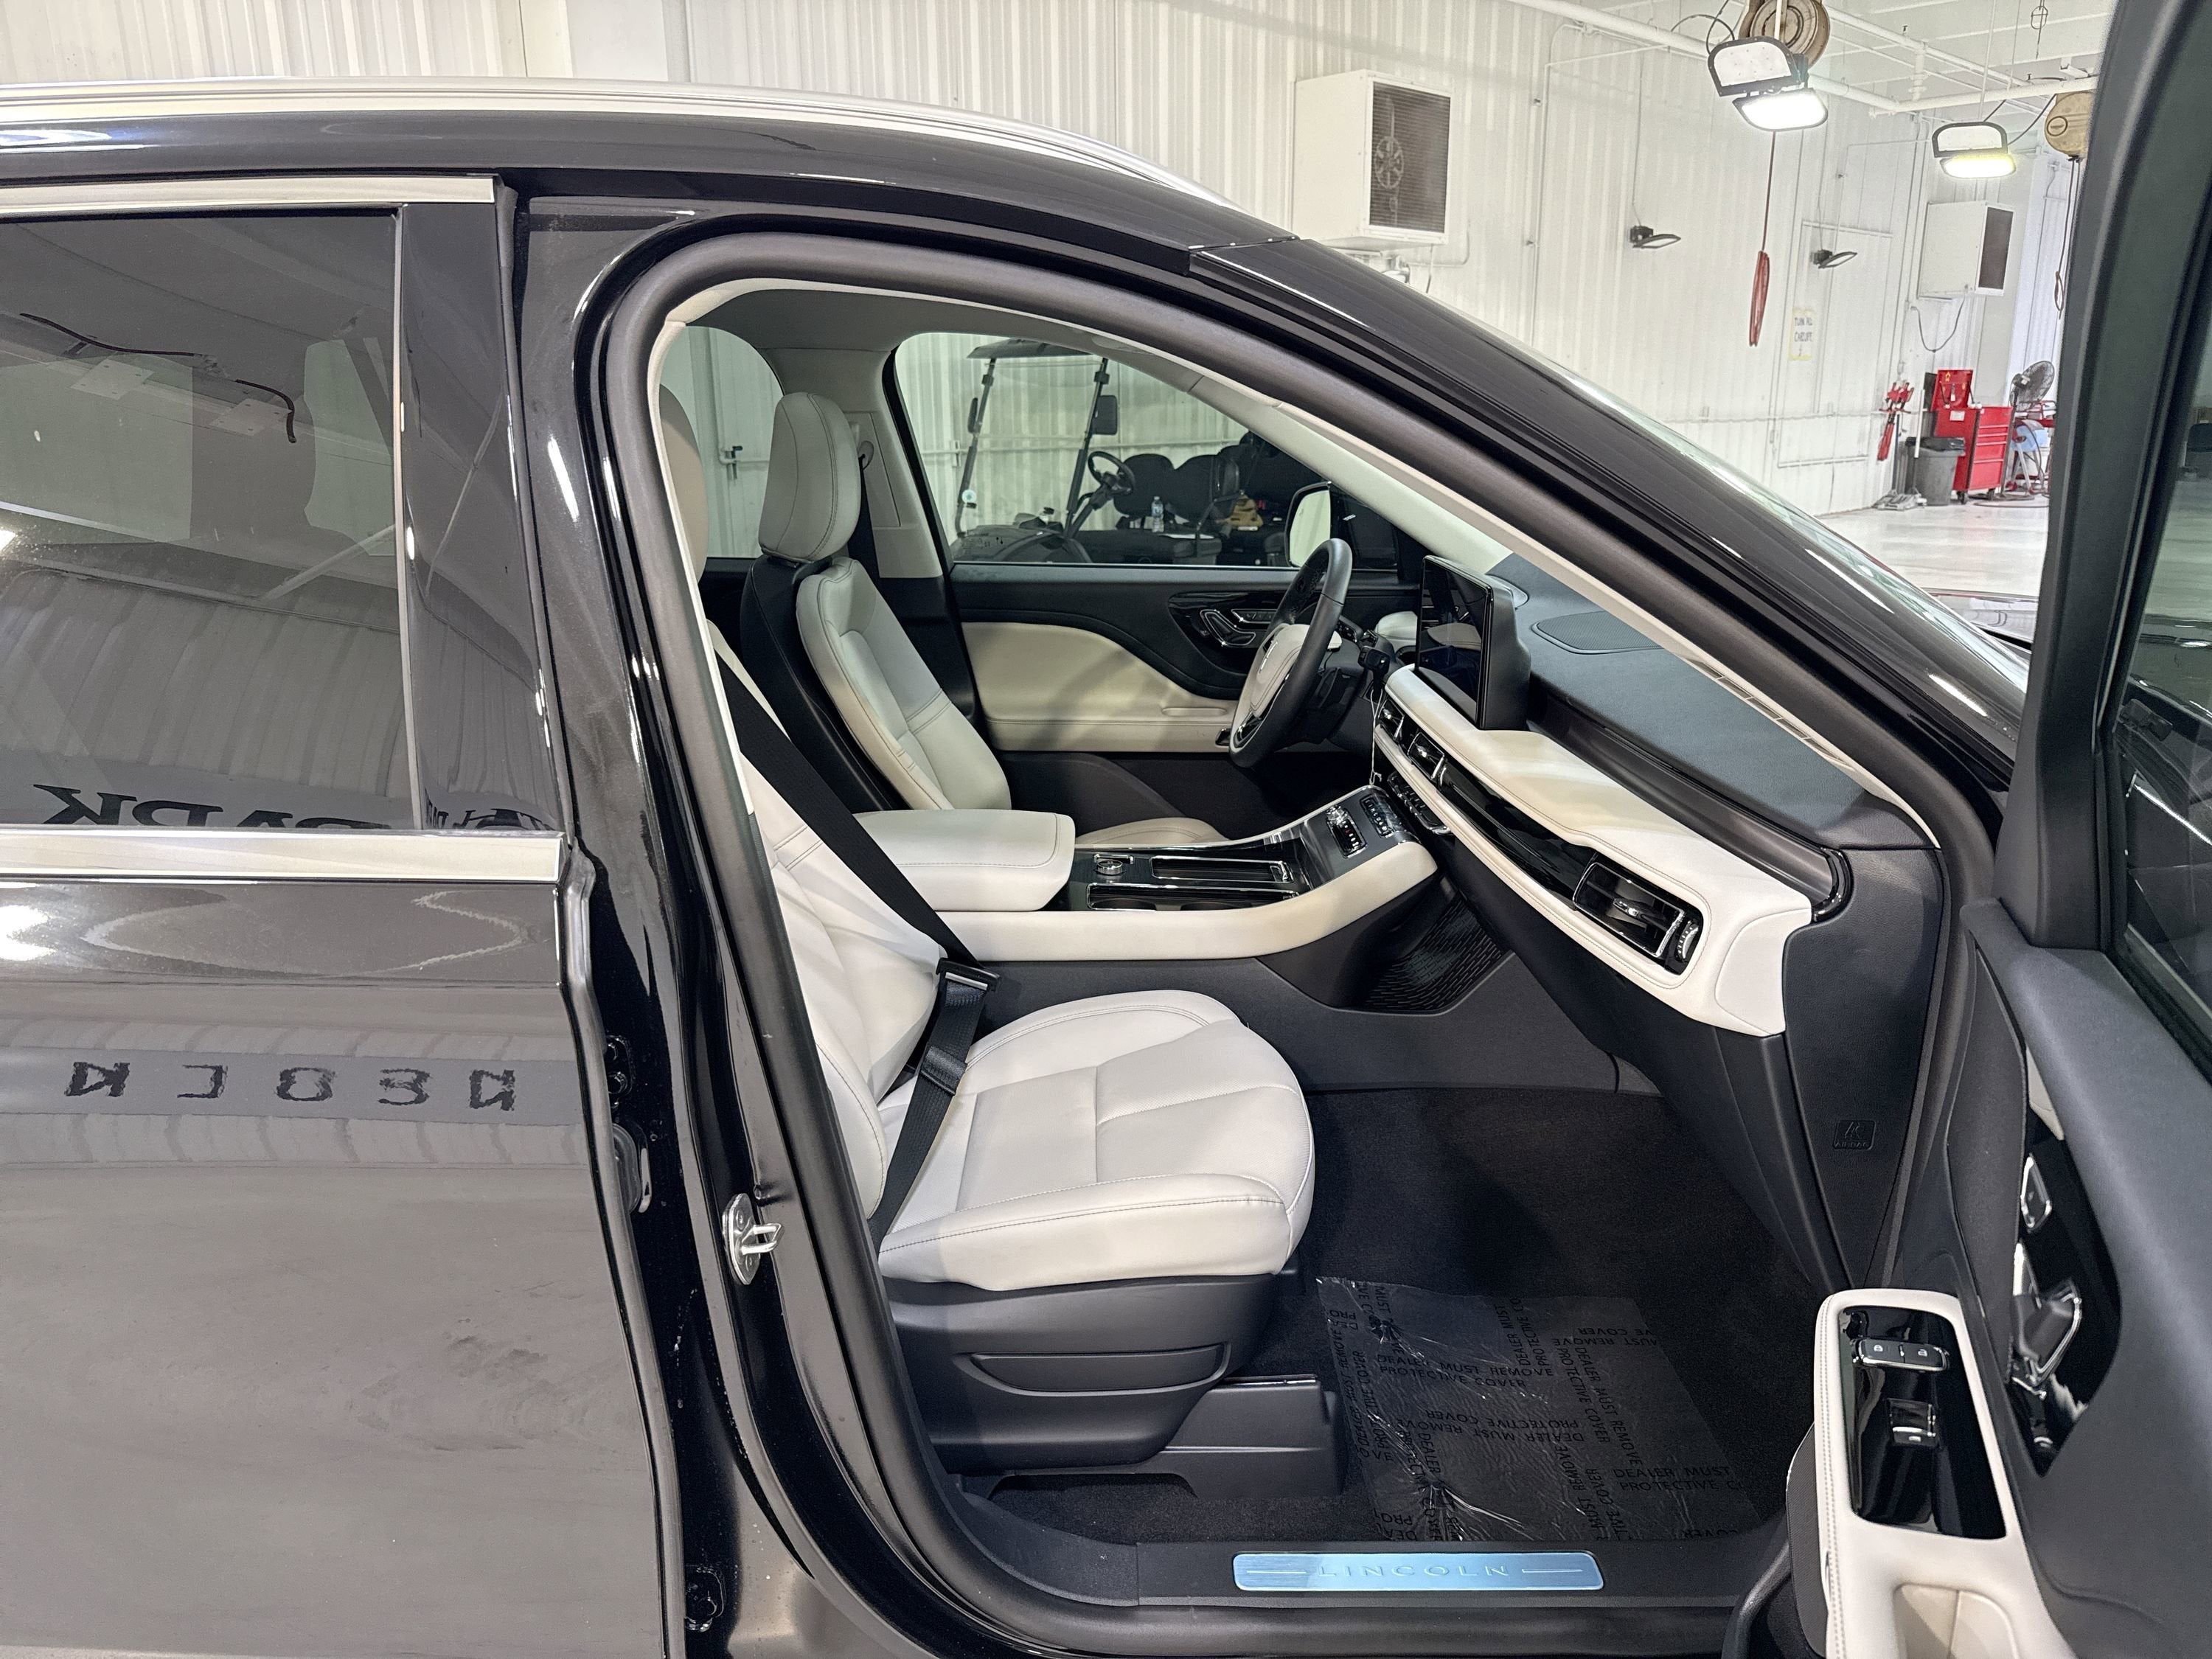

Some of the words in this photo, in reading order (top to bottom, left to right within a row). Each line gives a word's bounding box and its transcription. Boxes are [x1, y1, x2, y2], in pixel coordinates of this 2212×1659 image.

[1374, 1286, 1391, 1313] MUST
[1493, 1304, 1514, 1329] MUST
[1516, 1316, 1549, 1366] PROTECTIVE
[1551, 1338, 1615, 1346] REMOVE
[1577, 1328, 1627, 1336] COVER
[1329, 1328, 1349, 1368] REMOVE
[1506, 1333, 1531, 1366] DEALER
[1352, 1352, 1371, 1385] COVER
[1380, 1366, 1468, 1384] PROTECTIVE
[1475, 1377, 1526, 1388] COVER
[1440, 1363, 1480, 1374] MUST
[1489, 1366, 1554, 1377] REMOVE
[1557, 1348, 1592, 1404] PROTECTIVE
[1585, 1408, 1611, 1444] COVER
[1574, 1348, 1601, 1381] DEALER
[1593, 1388, 1618, 1416] MUST
[1610, 1421, 1643, 1465] REMOVE
[1425, 1410, 1478, 1425] COVER
[1486, 1418, 1579, 1429] PROTECTIVE
[1473, 1428, 1515, 1441] MUST
[1525, 1432, 1585, 1443] DEALER
[1418, 1433, 1441, 1473] DEALER
[1554, 1444, 1586, 1490] REMOVE
[1613, 1467, 1674, 1478] DEALER
[1683, 1466, 1730, 1476] MUST
[1585, 1468, 1613, 1505] COVER
[1619, 1480, 1719, 1491] PROTECTIVE
[1318, 1565, 1509, 1577] LINCOLN
